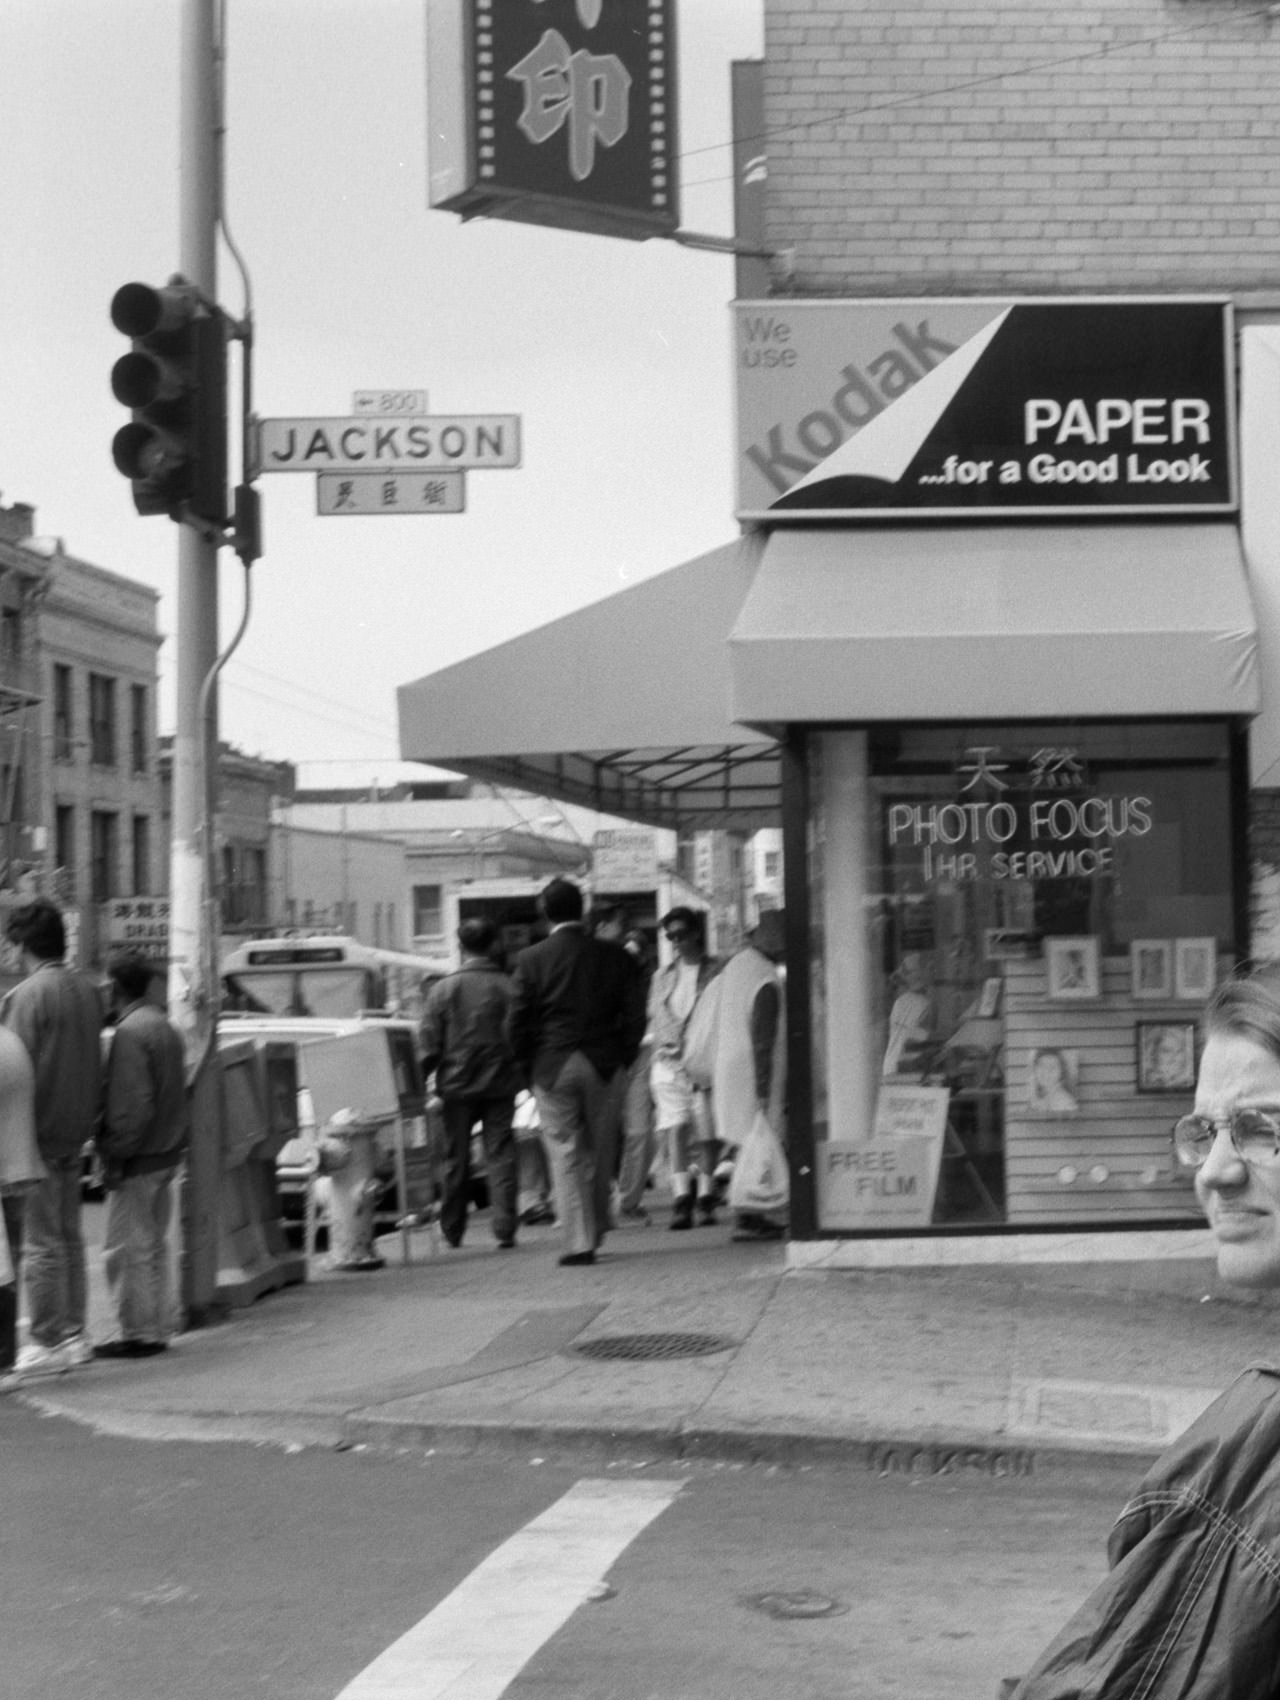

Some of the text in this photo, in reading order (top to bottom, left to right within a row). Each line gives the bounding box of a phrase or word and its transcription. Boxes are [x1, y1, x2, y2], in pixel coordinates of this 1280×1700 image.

[504, 0, 632, 181] 印
[744, 317, 791, 343] We
[742, 347, 797, 368] use
[746, 319, 961, 495] Kodak
[1024, 398, 1211, 445] PAPER
[272, 426, 505, 462] JACKSON
[918, 453, 1211, 484] ...for a Good Look
[955, 746, 1084, 792] 天然
[888, 796, 1152, 846] PHOTO FOCUS
[936, 853, 977, 881] HR
[990, 847, 1113, 880] SERVICE
[828, 1151, 896, 1174] FREE
[856, 1175, 917, 1197] FILM
